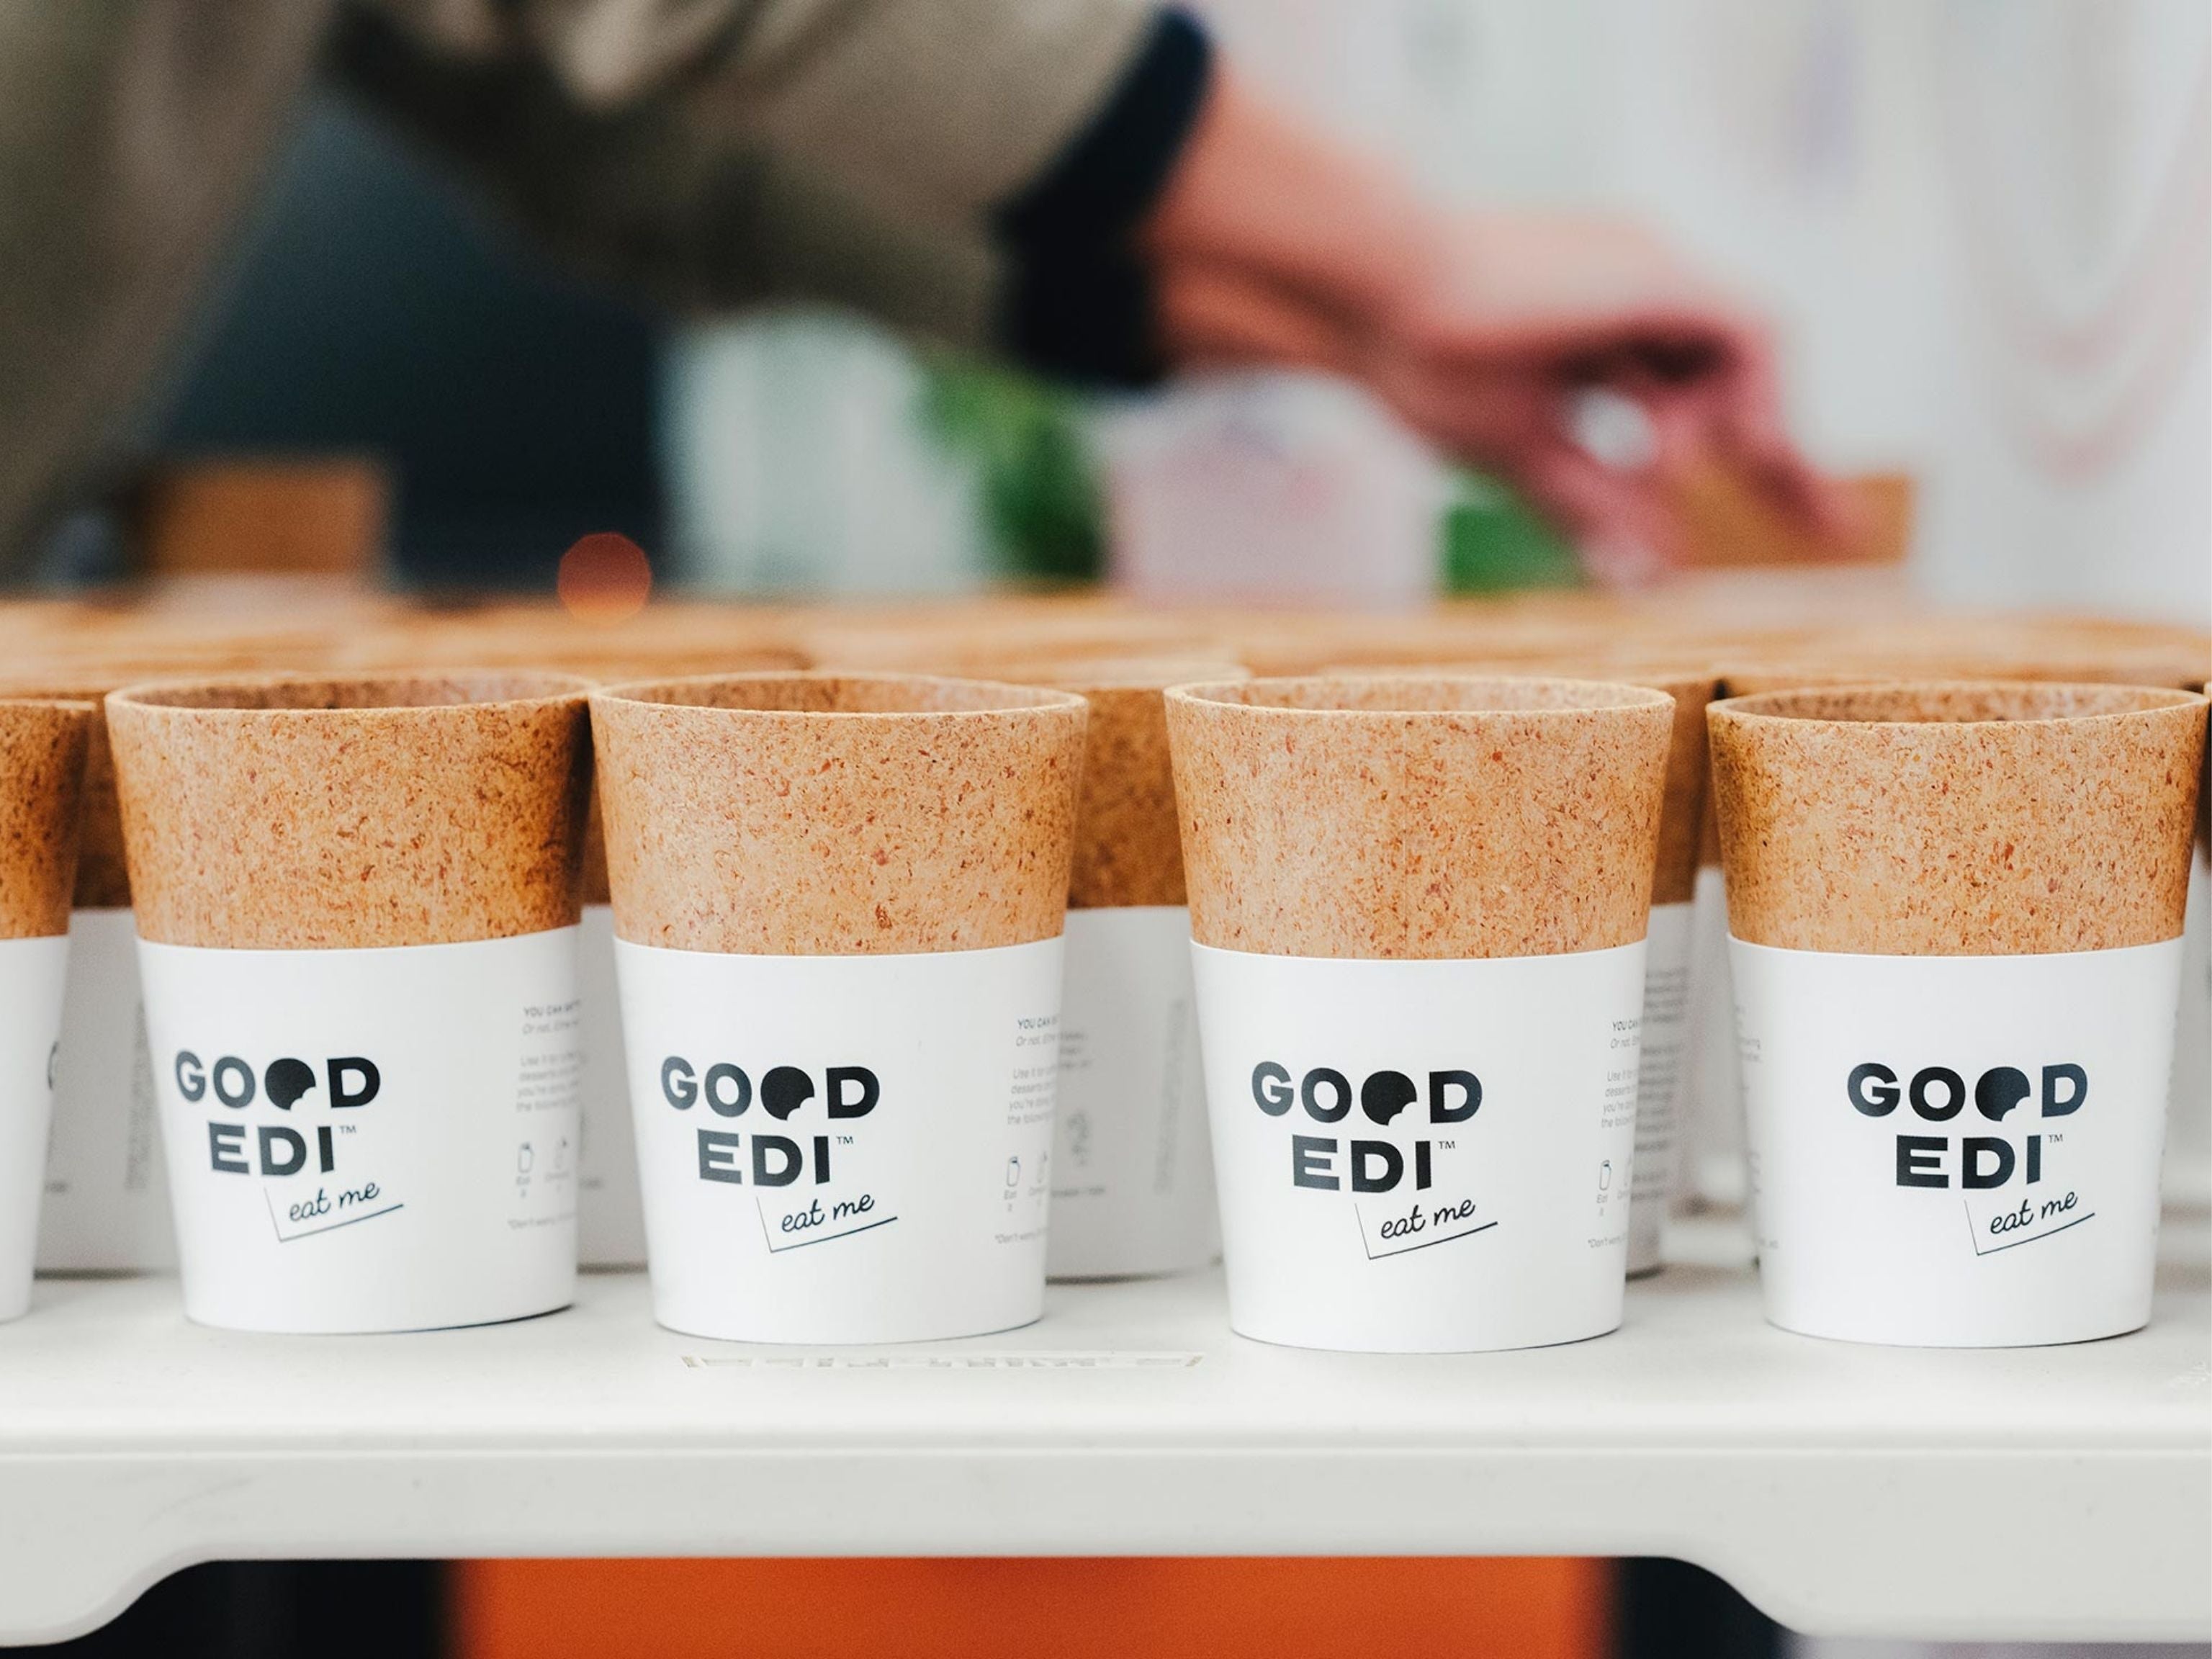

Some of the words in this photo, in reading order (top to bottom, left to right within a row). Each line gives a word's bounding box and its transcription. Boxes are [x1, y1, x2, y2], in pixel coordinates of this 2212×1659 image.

[175, 1050, 382, 1112] GOOD
[660, 1056, 881, 1122] GOOD
[1251, 1061, 1484, 1127] GOOD
[1846, 1061, 2089, 1123] GOOD
[207, 1120, 336, 1177] EDI
[696, 1128, 831, 1187] EDI
[1291, 1133, 1433, 1195] EDI
[1895, 1133, 2043, 1190] EDI
[289, 1189, 331, 1222] eat
[338, 1182, 381, 1208] me
[780, 1198, 826, 1233] eat
[832, 1193, 876, 1220] me
[1380, 1203, 1427, 1240] eat
[1433, 1198, 1477, 1227] me
[1989, 1197, 2035, 1236] eat
[2040, 1190, 2080, 1220] me
